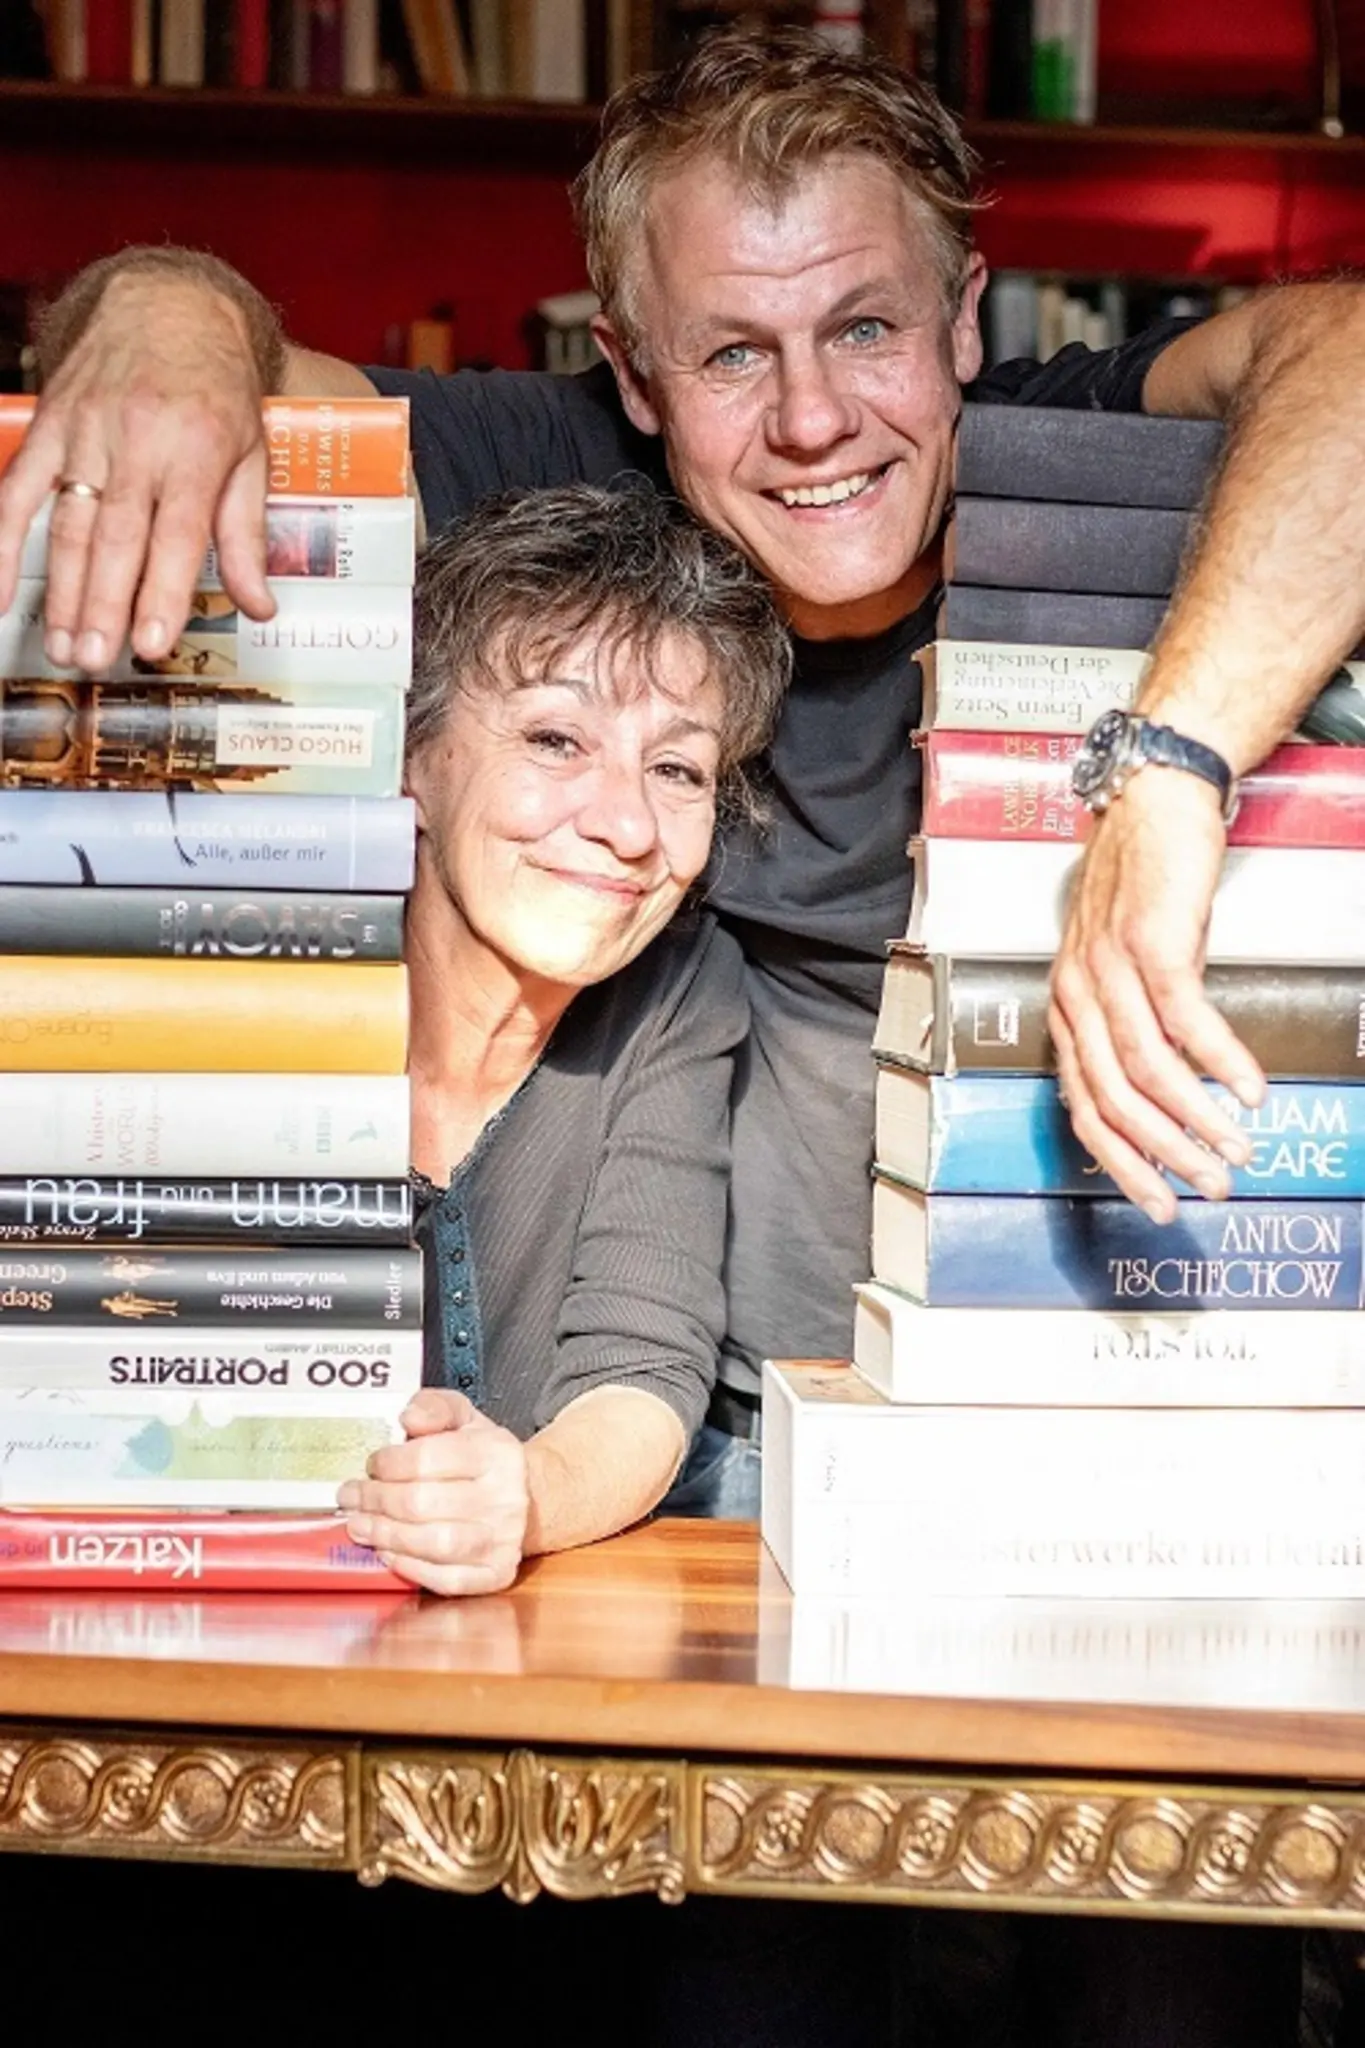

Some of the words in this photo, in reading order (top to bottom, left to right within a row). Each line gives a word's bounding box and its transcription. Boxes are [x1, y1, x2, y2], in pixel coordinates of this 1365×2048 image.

[269, 405, 290, 489] ECHO
[317, 404, 332, 492] POWERS
[251, 620, 399, 651] GOETHE
[954, 652, 1069, 676] Deutschen
[1074, 657, 1111, 676] der
[1096, 680, 1134, 702] Die
[954, 697, 1009, 720] Seitz
[1017, 700, 1083, 724] Erwin
[228, 734, 294, 753] CLAUS
[299, 736, 363, 755] HUGO
[196, 844, 234, 865] Alle,
[239, 844, 290, 863] außer
[297, 845, 327, 863] mir
[190, 903, 360, 959] SAVOY
[25, 1179, 150, 1239] frau
[160, 1185, 215, 1216] und
[231, 1183, 409, 1229] mann
[1220, 1213, 1343, 1254] ANTON
[206, 1269, 237, 1287] Eva
[238, 1269, 268, 1287] und
[271, 1269, 318, 1287] Adam
[319, 1270, 348, 1284] von
[1108, 1258, 1344, 1299] TSCHECHOW
[220, 1292, 304, 1311] Geschichte
[306, 1293, 332, 1310] Die
[384, 1262, 402, 1321] Siedler
[109, 1355, 288, 1386] PORTRAITS
[307, 1357, 391, 1389] 500
[49, 1535, 203, 1579] Katzen
